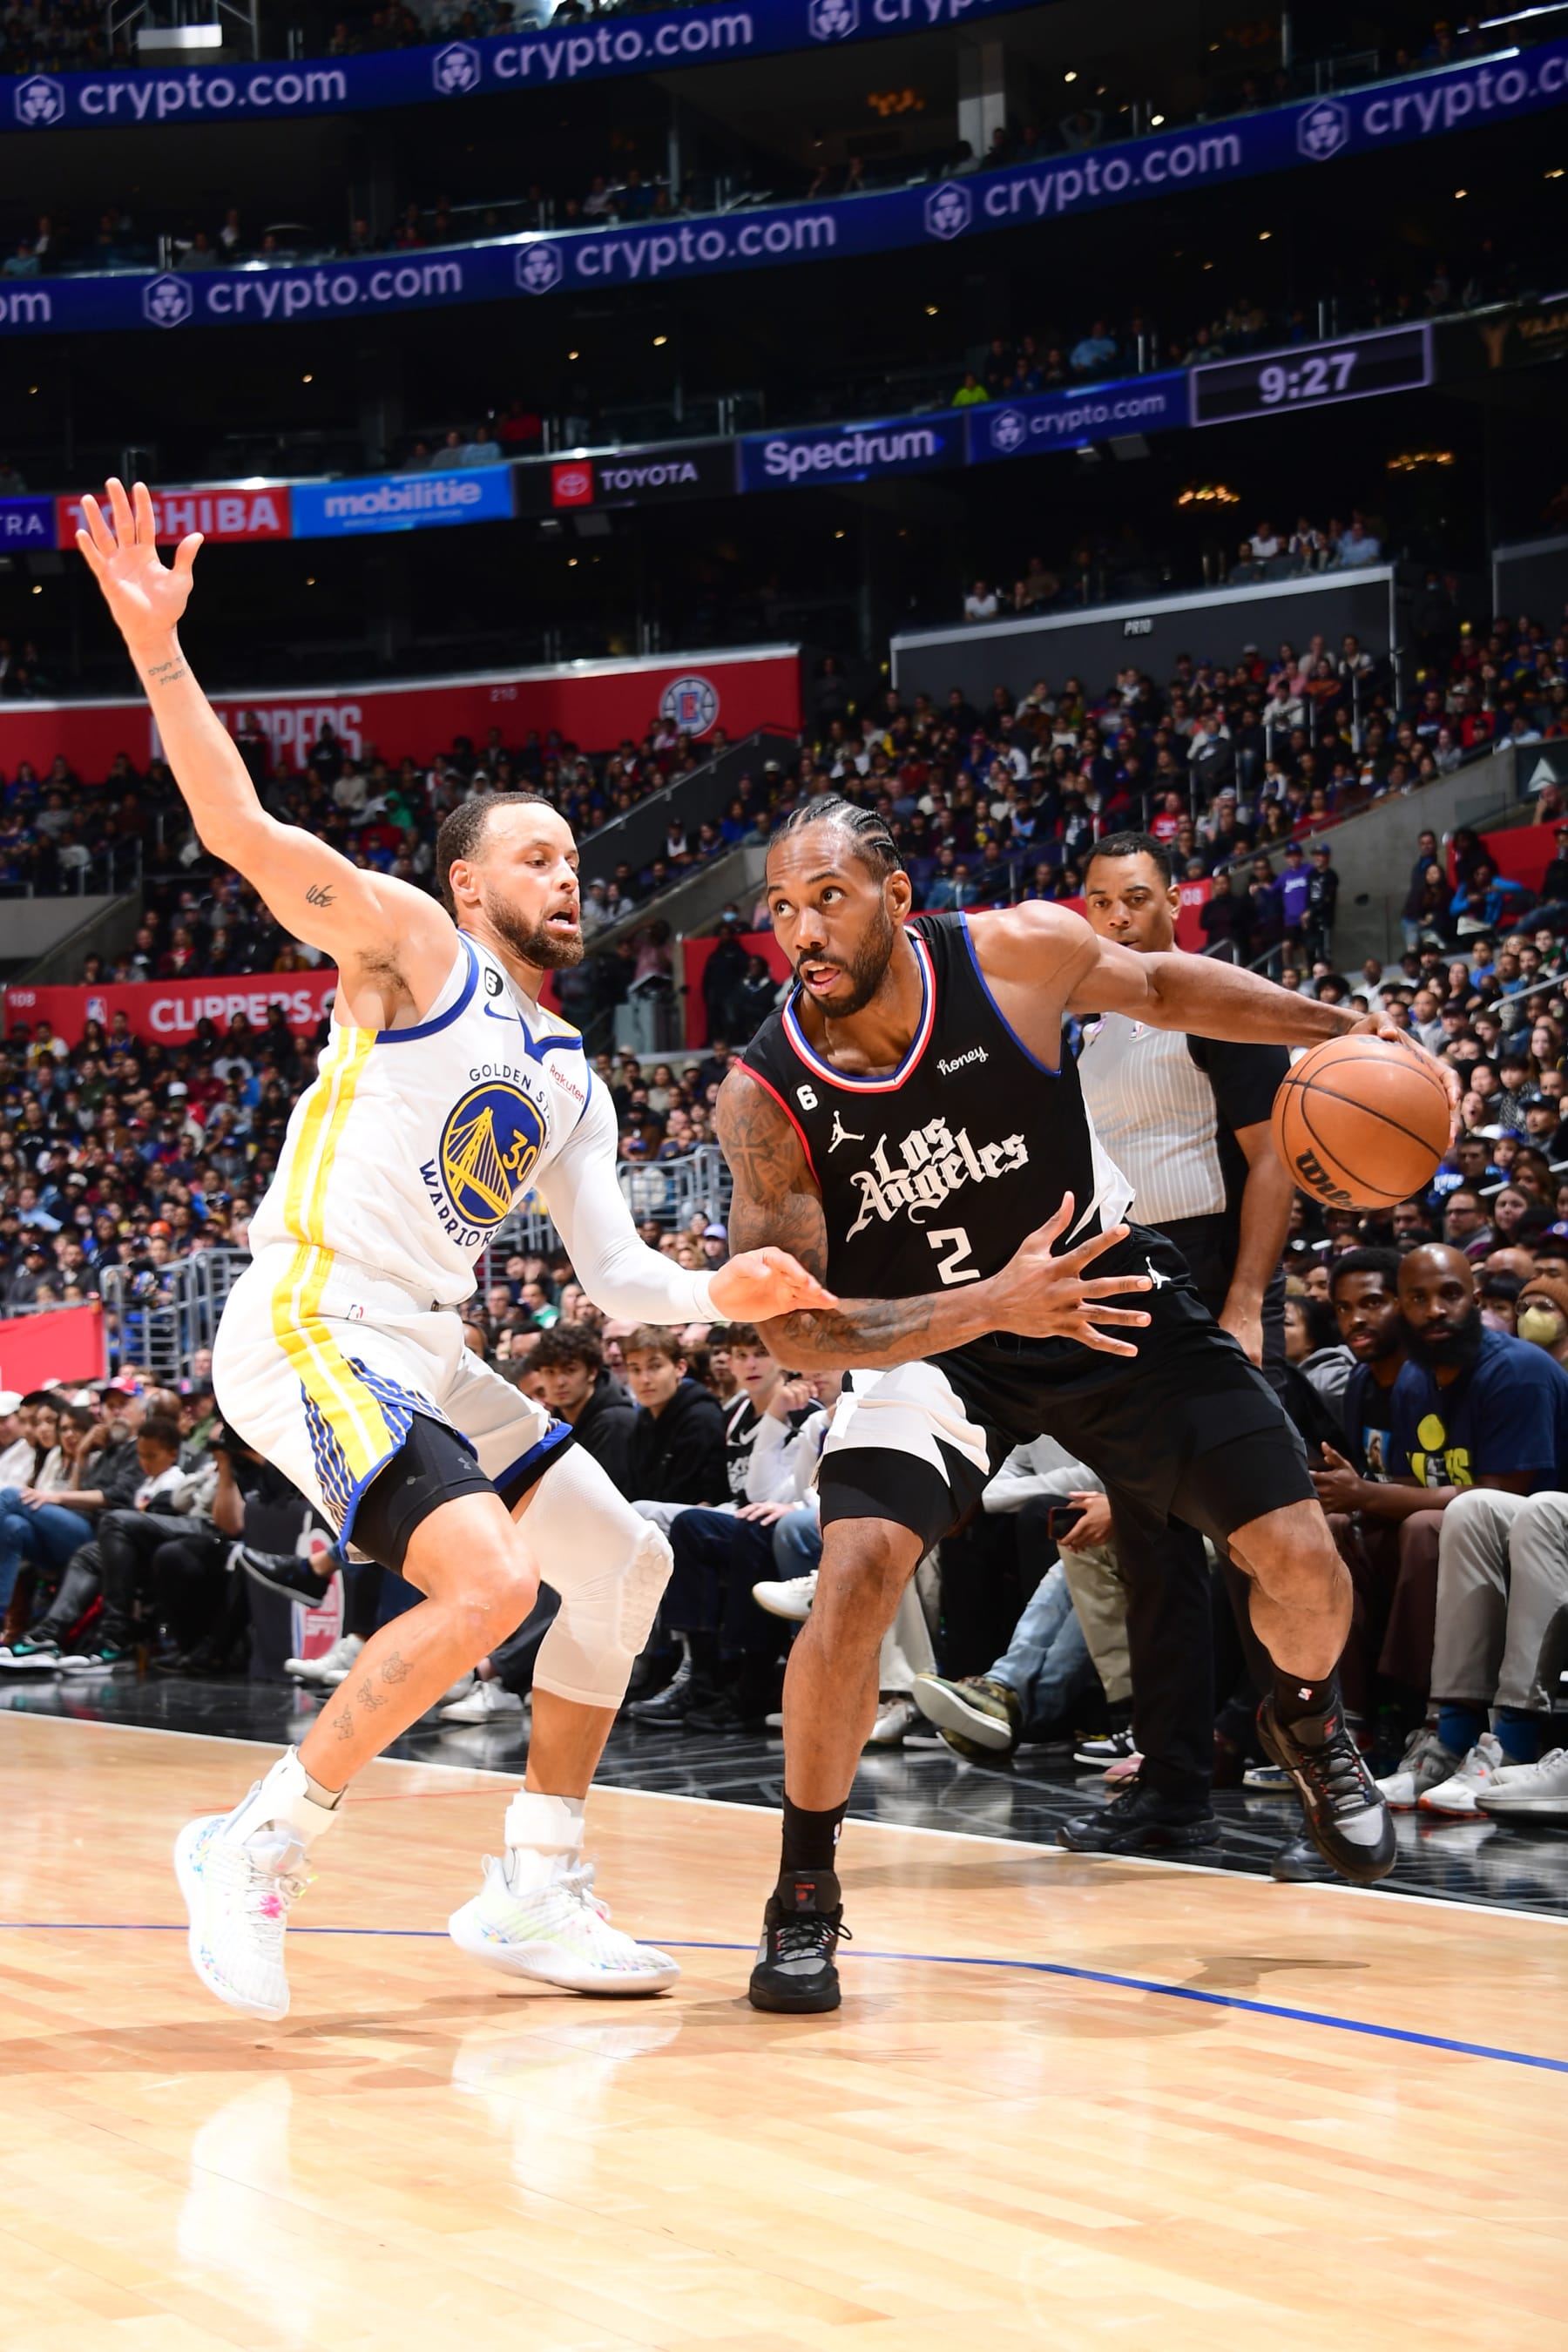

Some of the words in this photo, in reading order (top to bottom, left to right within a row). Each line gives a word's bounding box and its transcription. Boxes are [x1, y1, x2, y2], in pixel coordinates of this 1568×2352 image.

[494, 13, 754, 79] crypto.com
[79, 70, 347, 119] crypto.com
[1362, 57, 1568, 135] crypto.c
[984, 135, 1240, 216] crypto.com
[576, 215, 837, 279] crypto.com
[206, 262, 463, 317] crypto.com
[1259, 352, 1358, 403] 9:27
[1030, 394, 1166, 436] crypto.com
[600, 461, 700, 490] TOYOTA
[764, 429, 935, 482] Spectrum
[324, 478, 482, 518] mobilitie
[0, 512, 44, 537] RA
[486, 970, 500, 996] 6
[469, 1063, 532, 1091] GOLDEN
[549, 1063, 585, 1105] Rakuten
[936, 1045, 989, 1076] honey
[796, 1084, 819, 1112] 6
[502, 1129, 537, 1182] 30
[870, 1116, 956, 1187] Los
[419, 1158, 503, 1248] WARRIOR
[846, 1127, 1030, 1243] Angeles
[926, 1227, 981, 1285] 2
